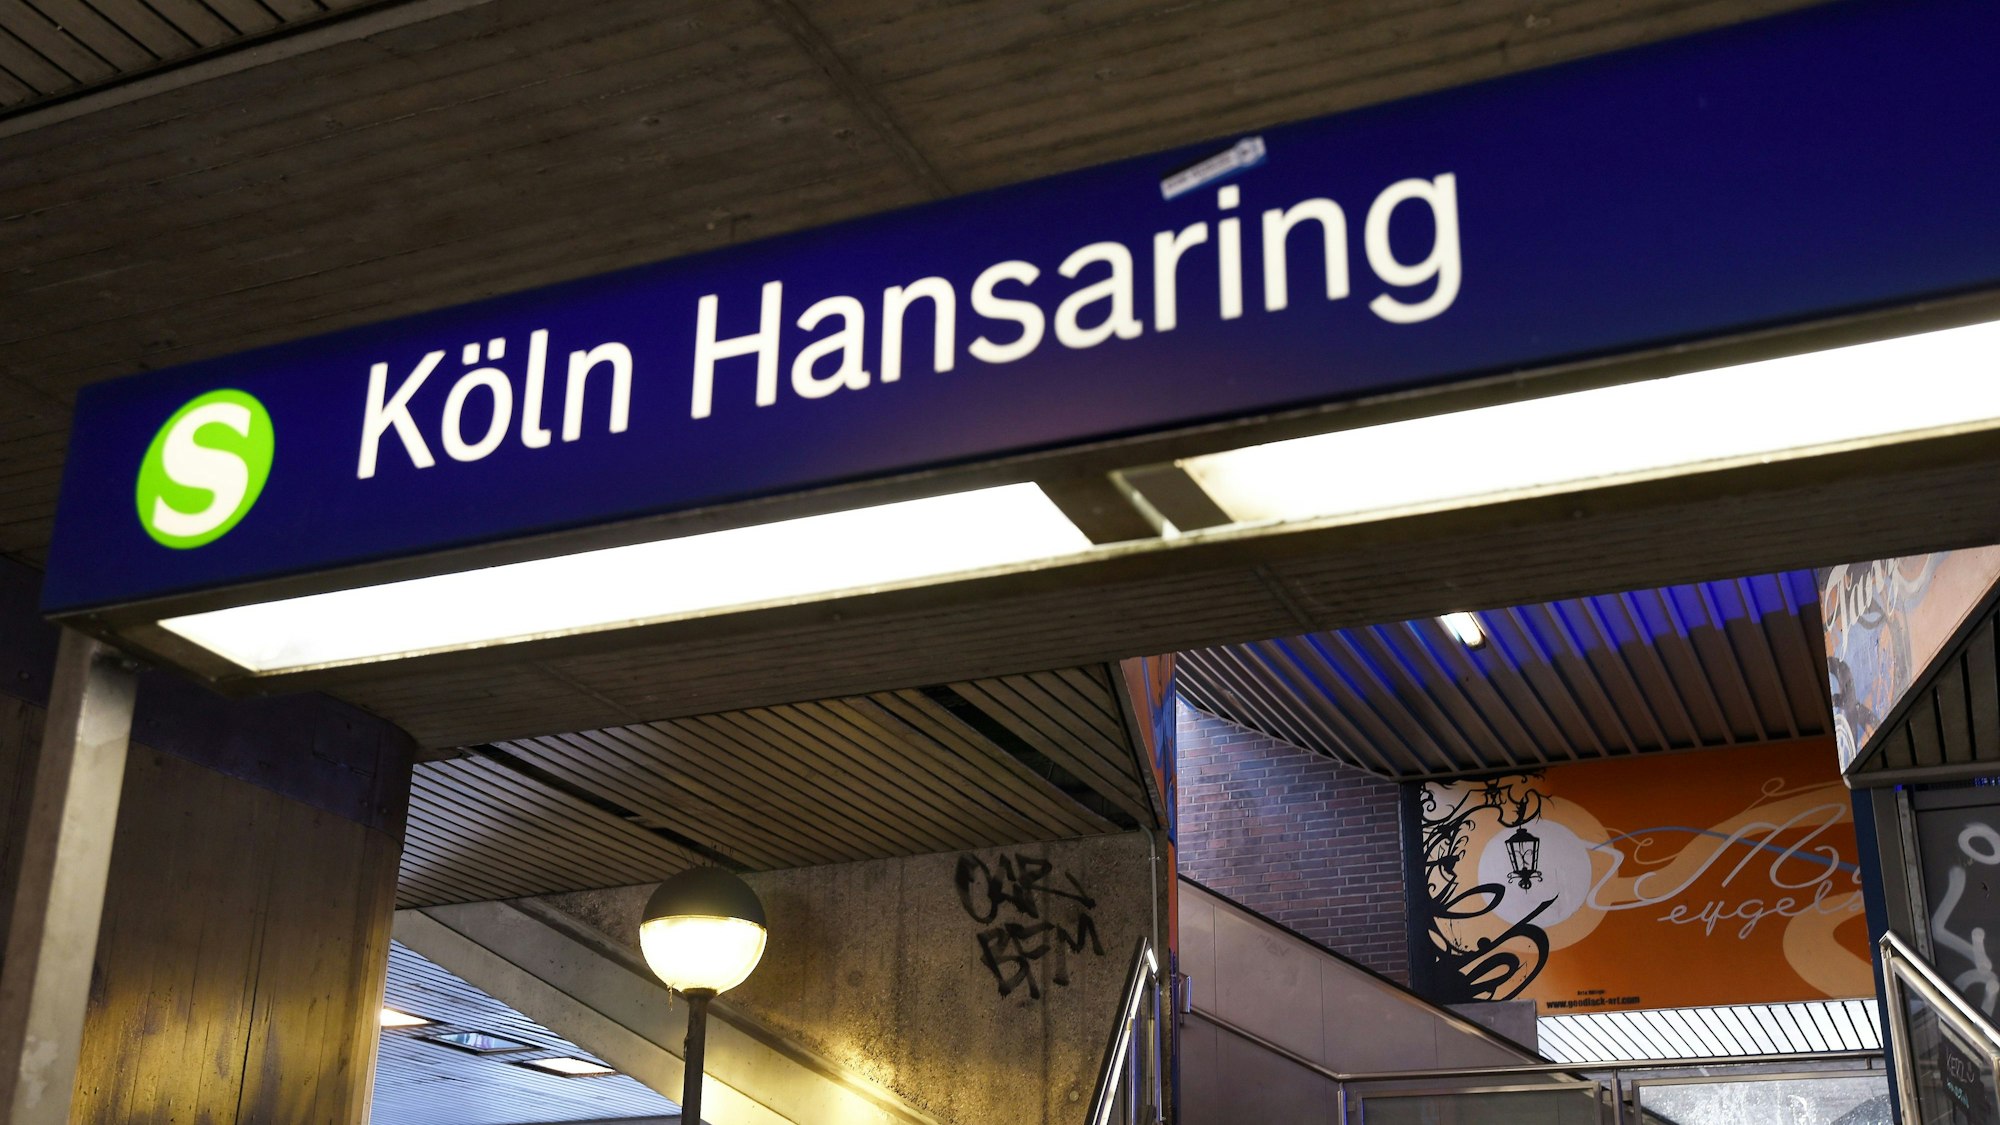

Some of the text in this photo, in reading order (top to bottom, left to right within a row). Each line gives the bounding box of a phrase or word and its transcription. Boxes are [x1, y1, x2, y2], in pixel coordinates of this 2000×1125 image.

[153, 172, 1463, 536] S Köln Hansaring
